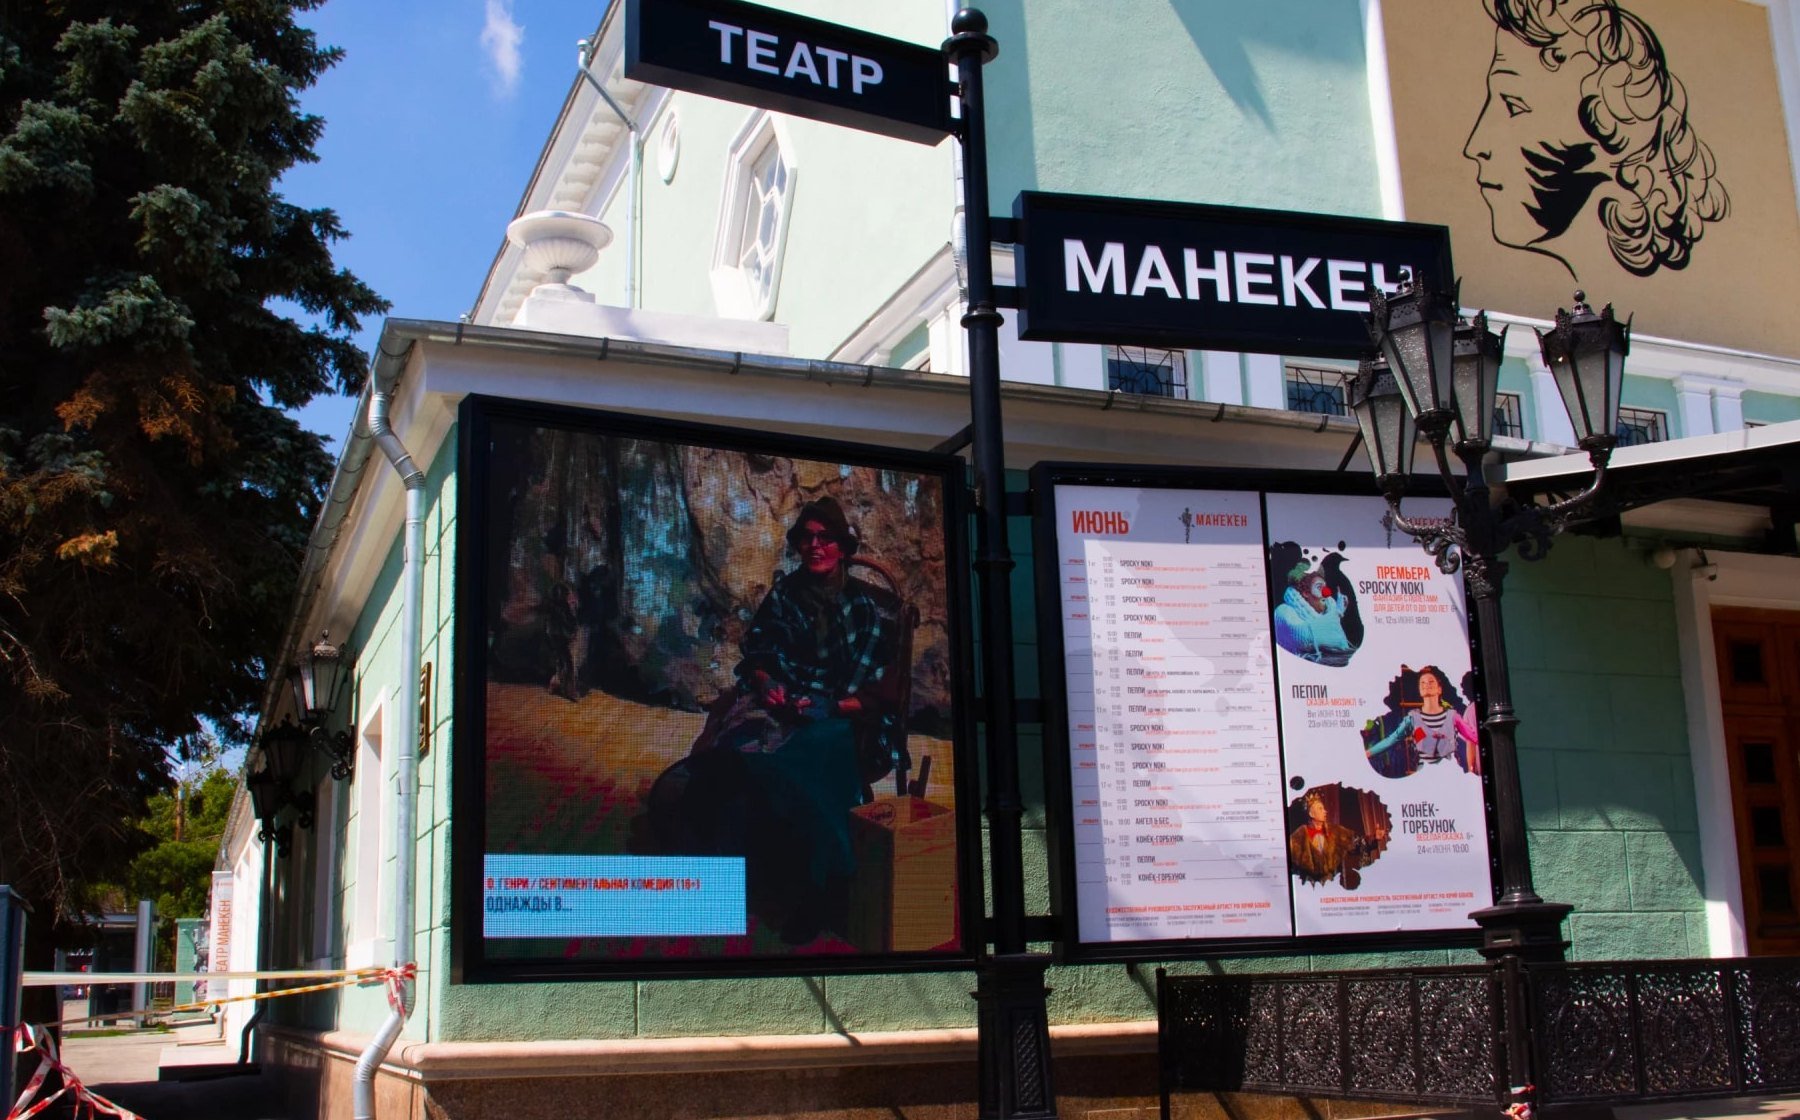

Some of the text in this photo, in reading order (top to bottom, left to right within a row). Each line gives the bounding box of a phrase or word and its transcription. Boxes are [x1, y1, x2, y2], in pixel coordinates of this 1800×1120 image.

[708, 20, 884, 94] ТЕАТР
[1072, 510, 1129, 535] ИЮНЬ
[1195, 513, 1248, 527] МАНЕКЕН
[1376, 566, 1430, 580] ПРЕМЬЕРА
[1121, 578, 1142, 586] SPOCKY
[1359, 581, 1424, 595] SPOCKY NOKI
[1122, 596, 1143, 604] SPOCKY
[1123, 614, 1143, 622] SPOCKY
[1292, 684, 1328, 699] ПЕППИ
[1401, 801, 1439, 818] КОНЁК-
[1403, 819, 1456, 834] ГОРБУНОК
[1452, 844, 1469, 853] 10:00
[498, 878, 528, 890] ГЕНРИ
[539, 878, 629, 890] СЕНТИМЕНТАЛЬНАЯ
[631, 878, 674, 891] КОМЕДИЯ
[486, 896, 552, 913] ОДНАЖДЫ
[216, 900, 230, 946] МАНЕКЕН
[216, 948, 228, 972] ЕАТР
